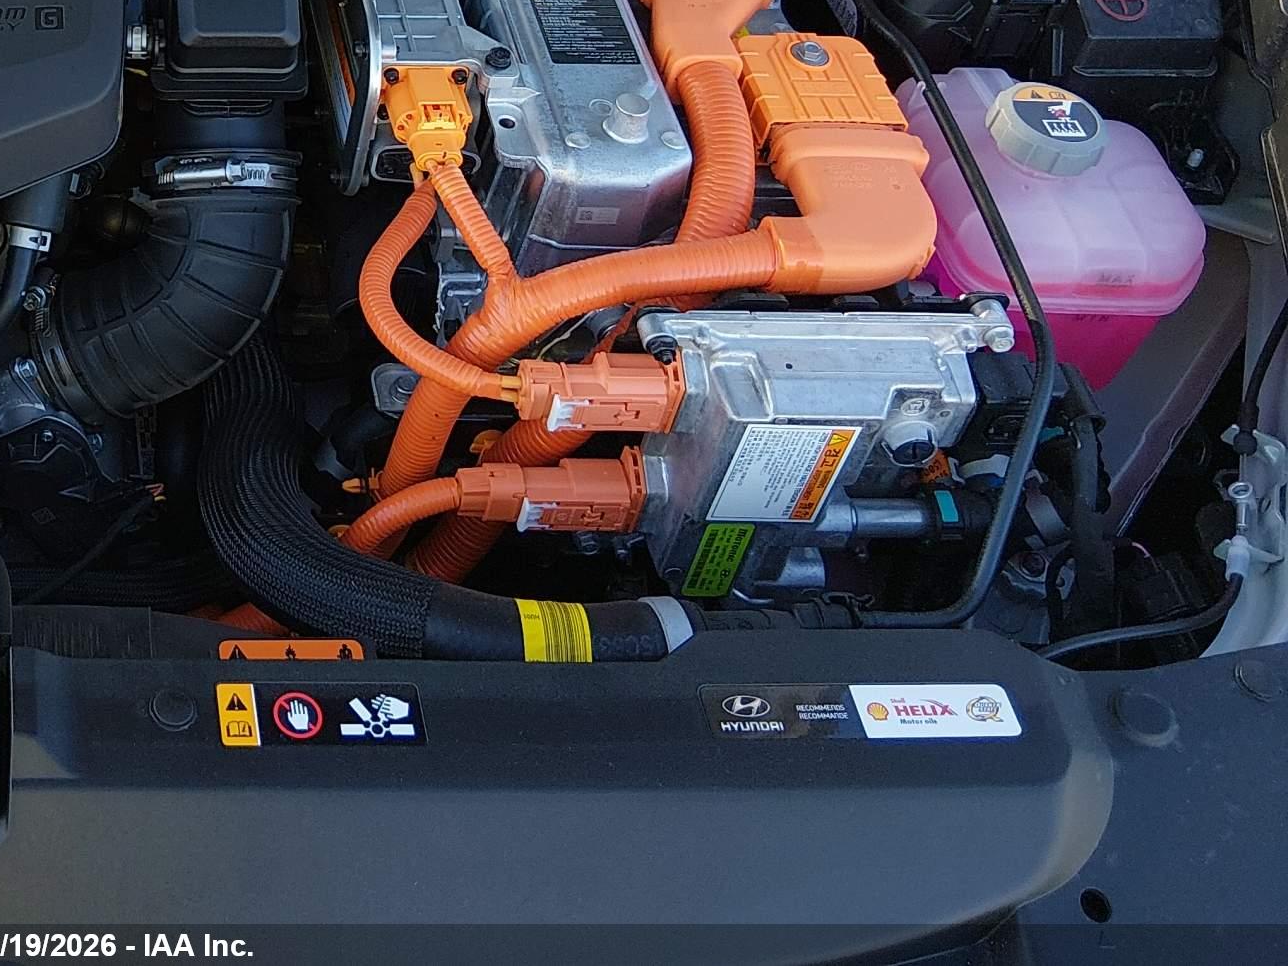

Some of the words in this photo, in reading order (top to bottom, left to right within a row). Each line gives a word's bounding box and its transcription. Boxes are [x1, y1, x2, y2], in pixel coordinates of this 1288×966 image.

[796, 704, 846, 712] RECOMMENDS
[893, 704, 956, 717] HELIX
[799, 712, 849, 720] RECOMMANDE
[720, 721, 784, 732] HYUNDAI
